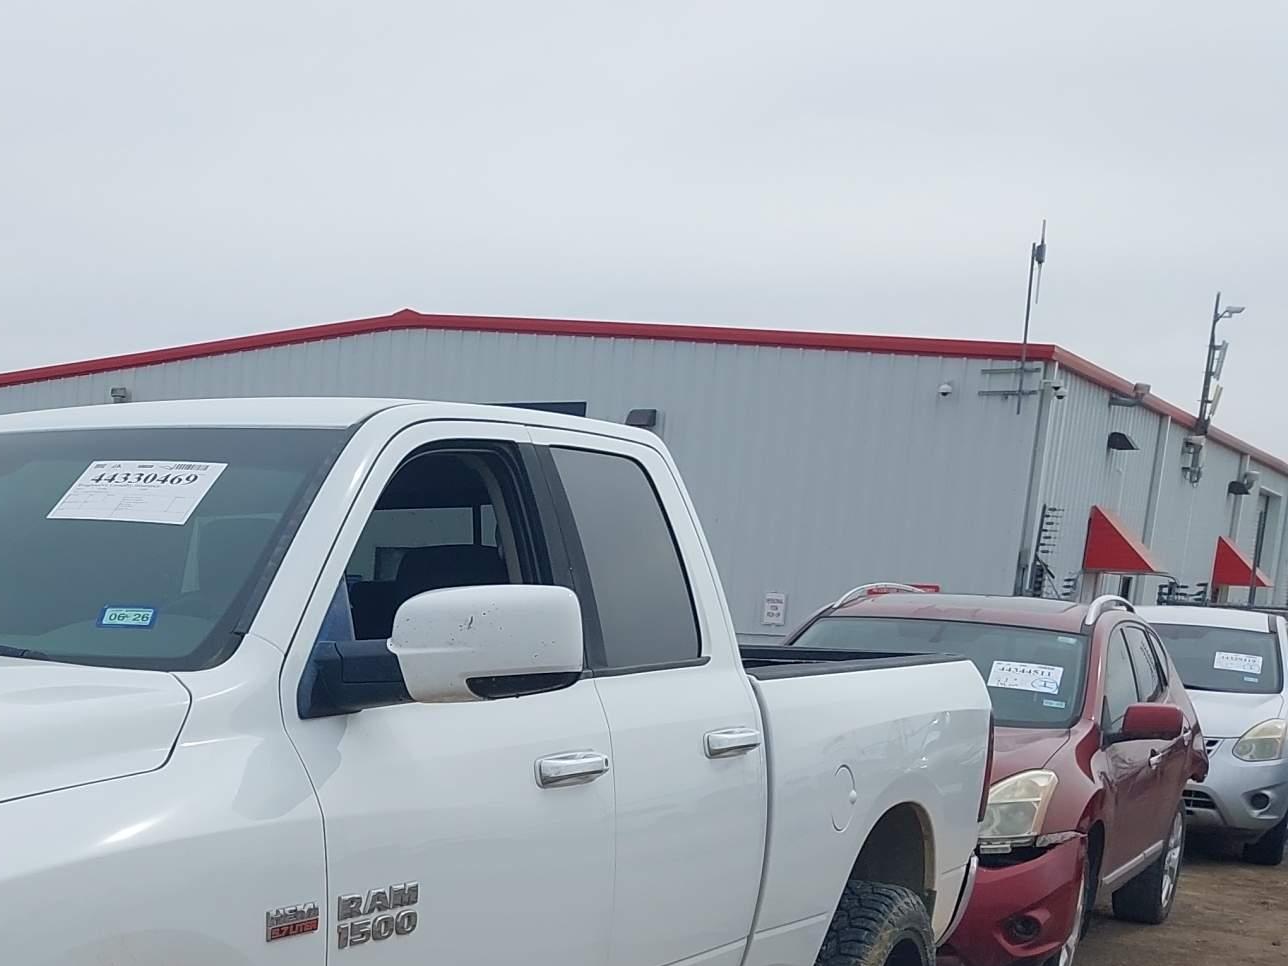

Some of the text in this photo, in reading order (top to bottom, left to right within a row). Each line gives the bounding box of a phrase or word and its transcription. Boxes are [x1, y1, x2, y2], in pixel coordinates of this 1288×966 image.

[91, 472, 199, 486] 44330469
[109, 613, 150, 622] 06 26
[337, 881, 419, 921] RAM
[289, 919, 317, 936] LITER
[337, 909, 419, 949] 1500
